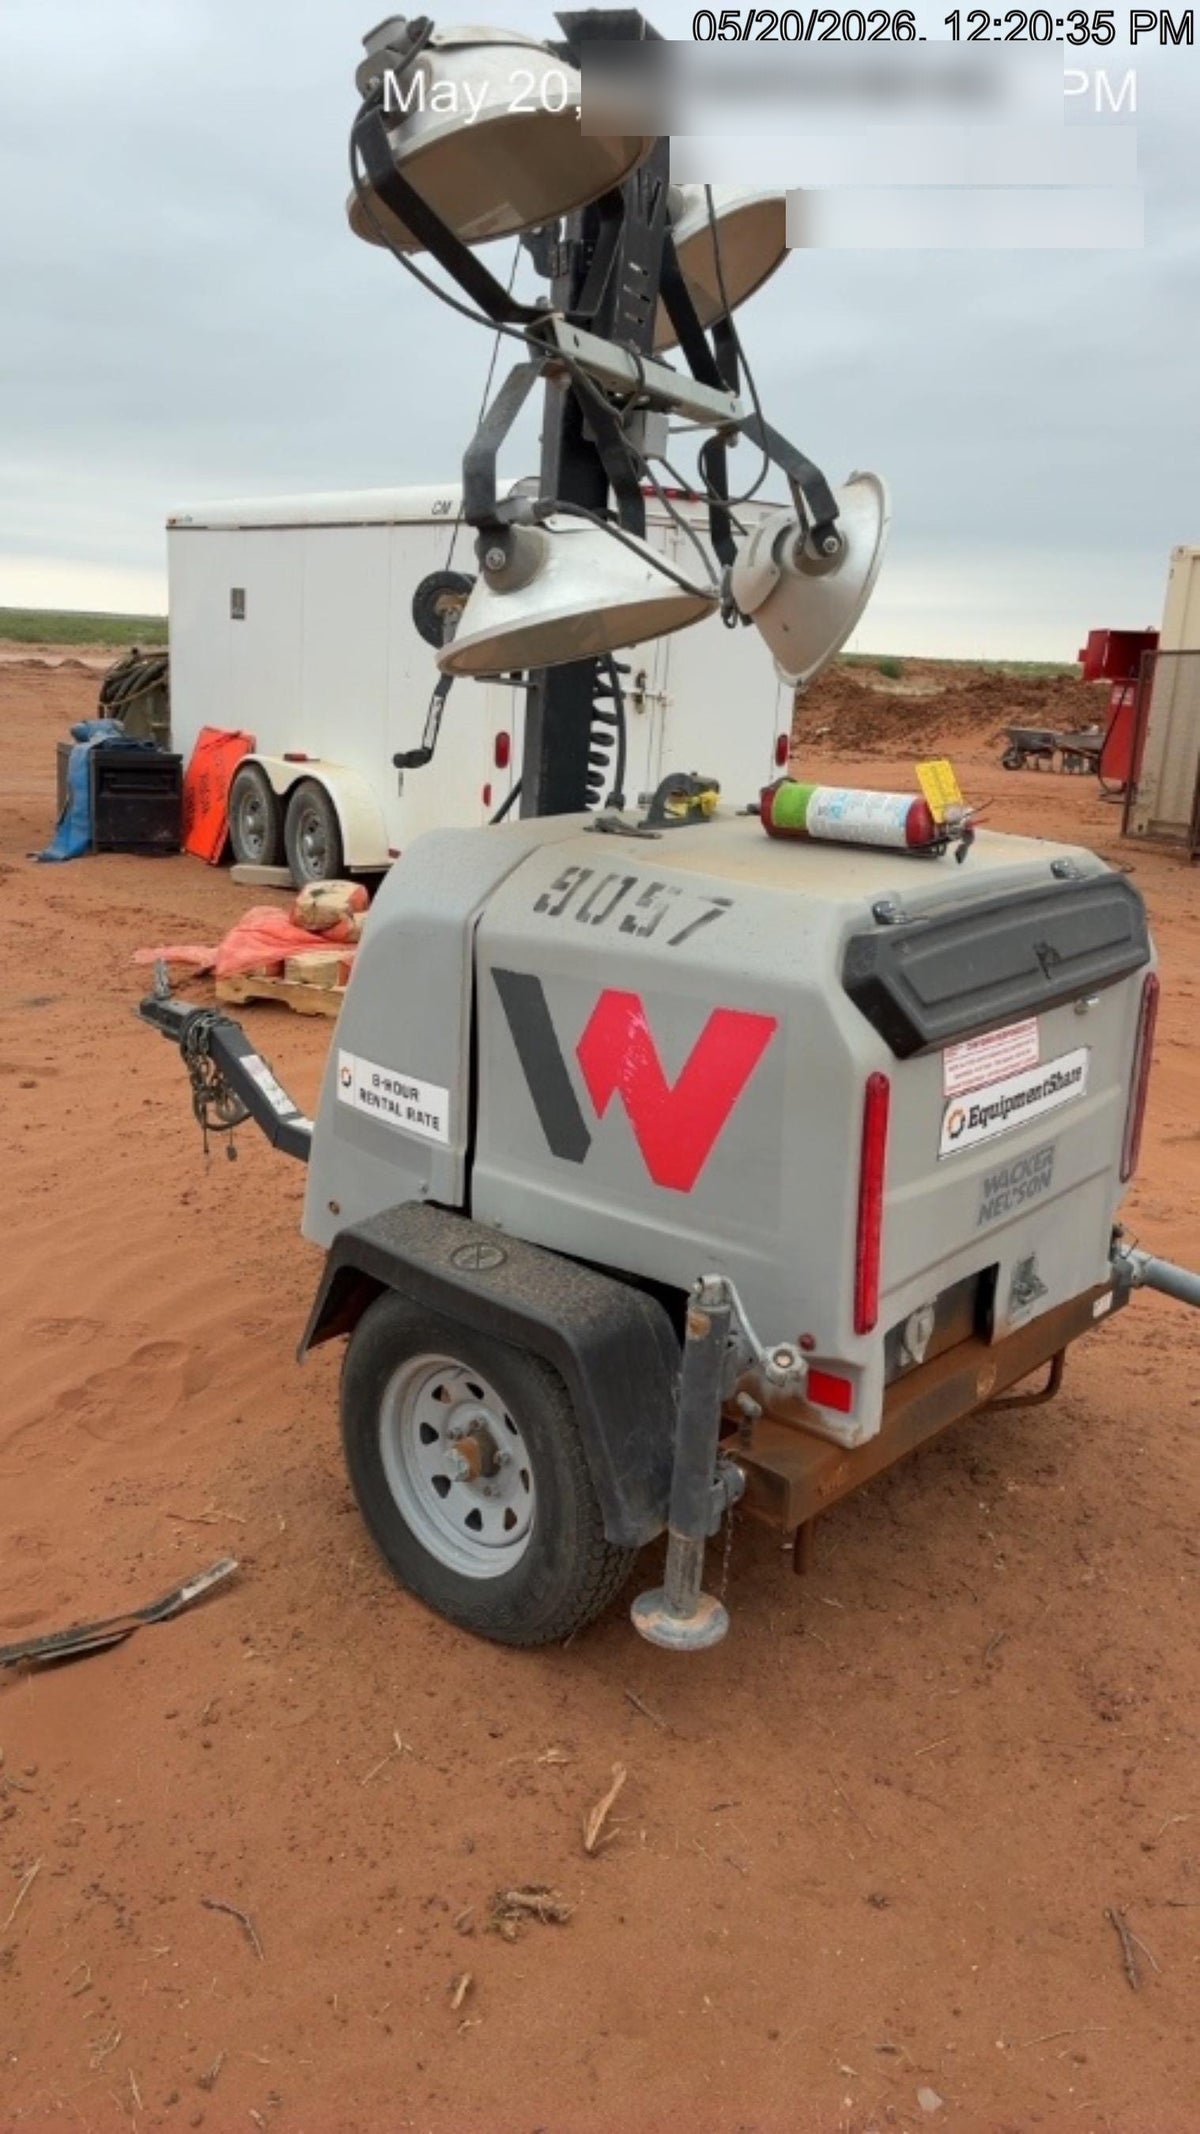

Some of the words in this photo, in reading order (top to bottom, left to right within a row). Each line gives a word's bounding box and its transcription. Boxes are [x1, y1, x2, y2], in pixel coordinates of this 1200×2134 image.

[533, 866, 735, 947] 9057
[359, 1087, 402, 1117] RENTAL
[406, 1106, 440, 1132] RATE
[967, 1065, 1083, 1128] EquipmentShare
[982, 1144, 1056, 1199] WACKER
